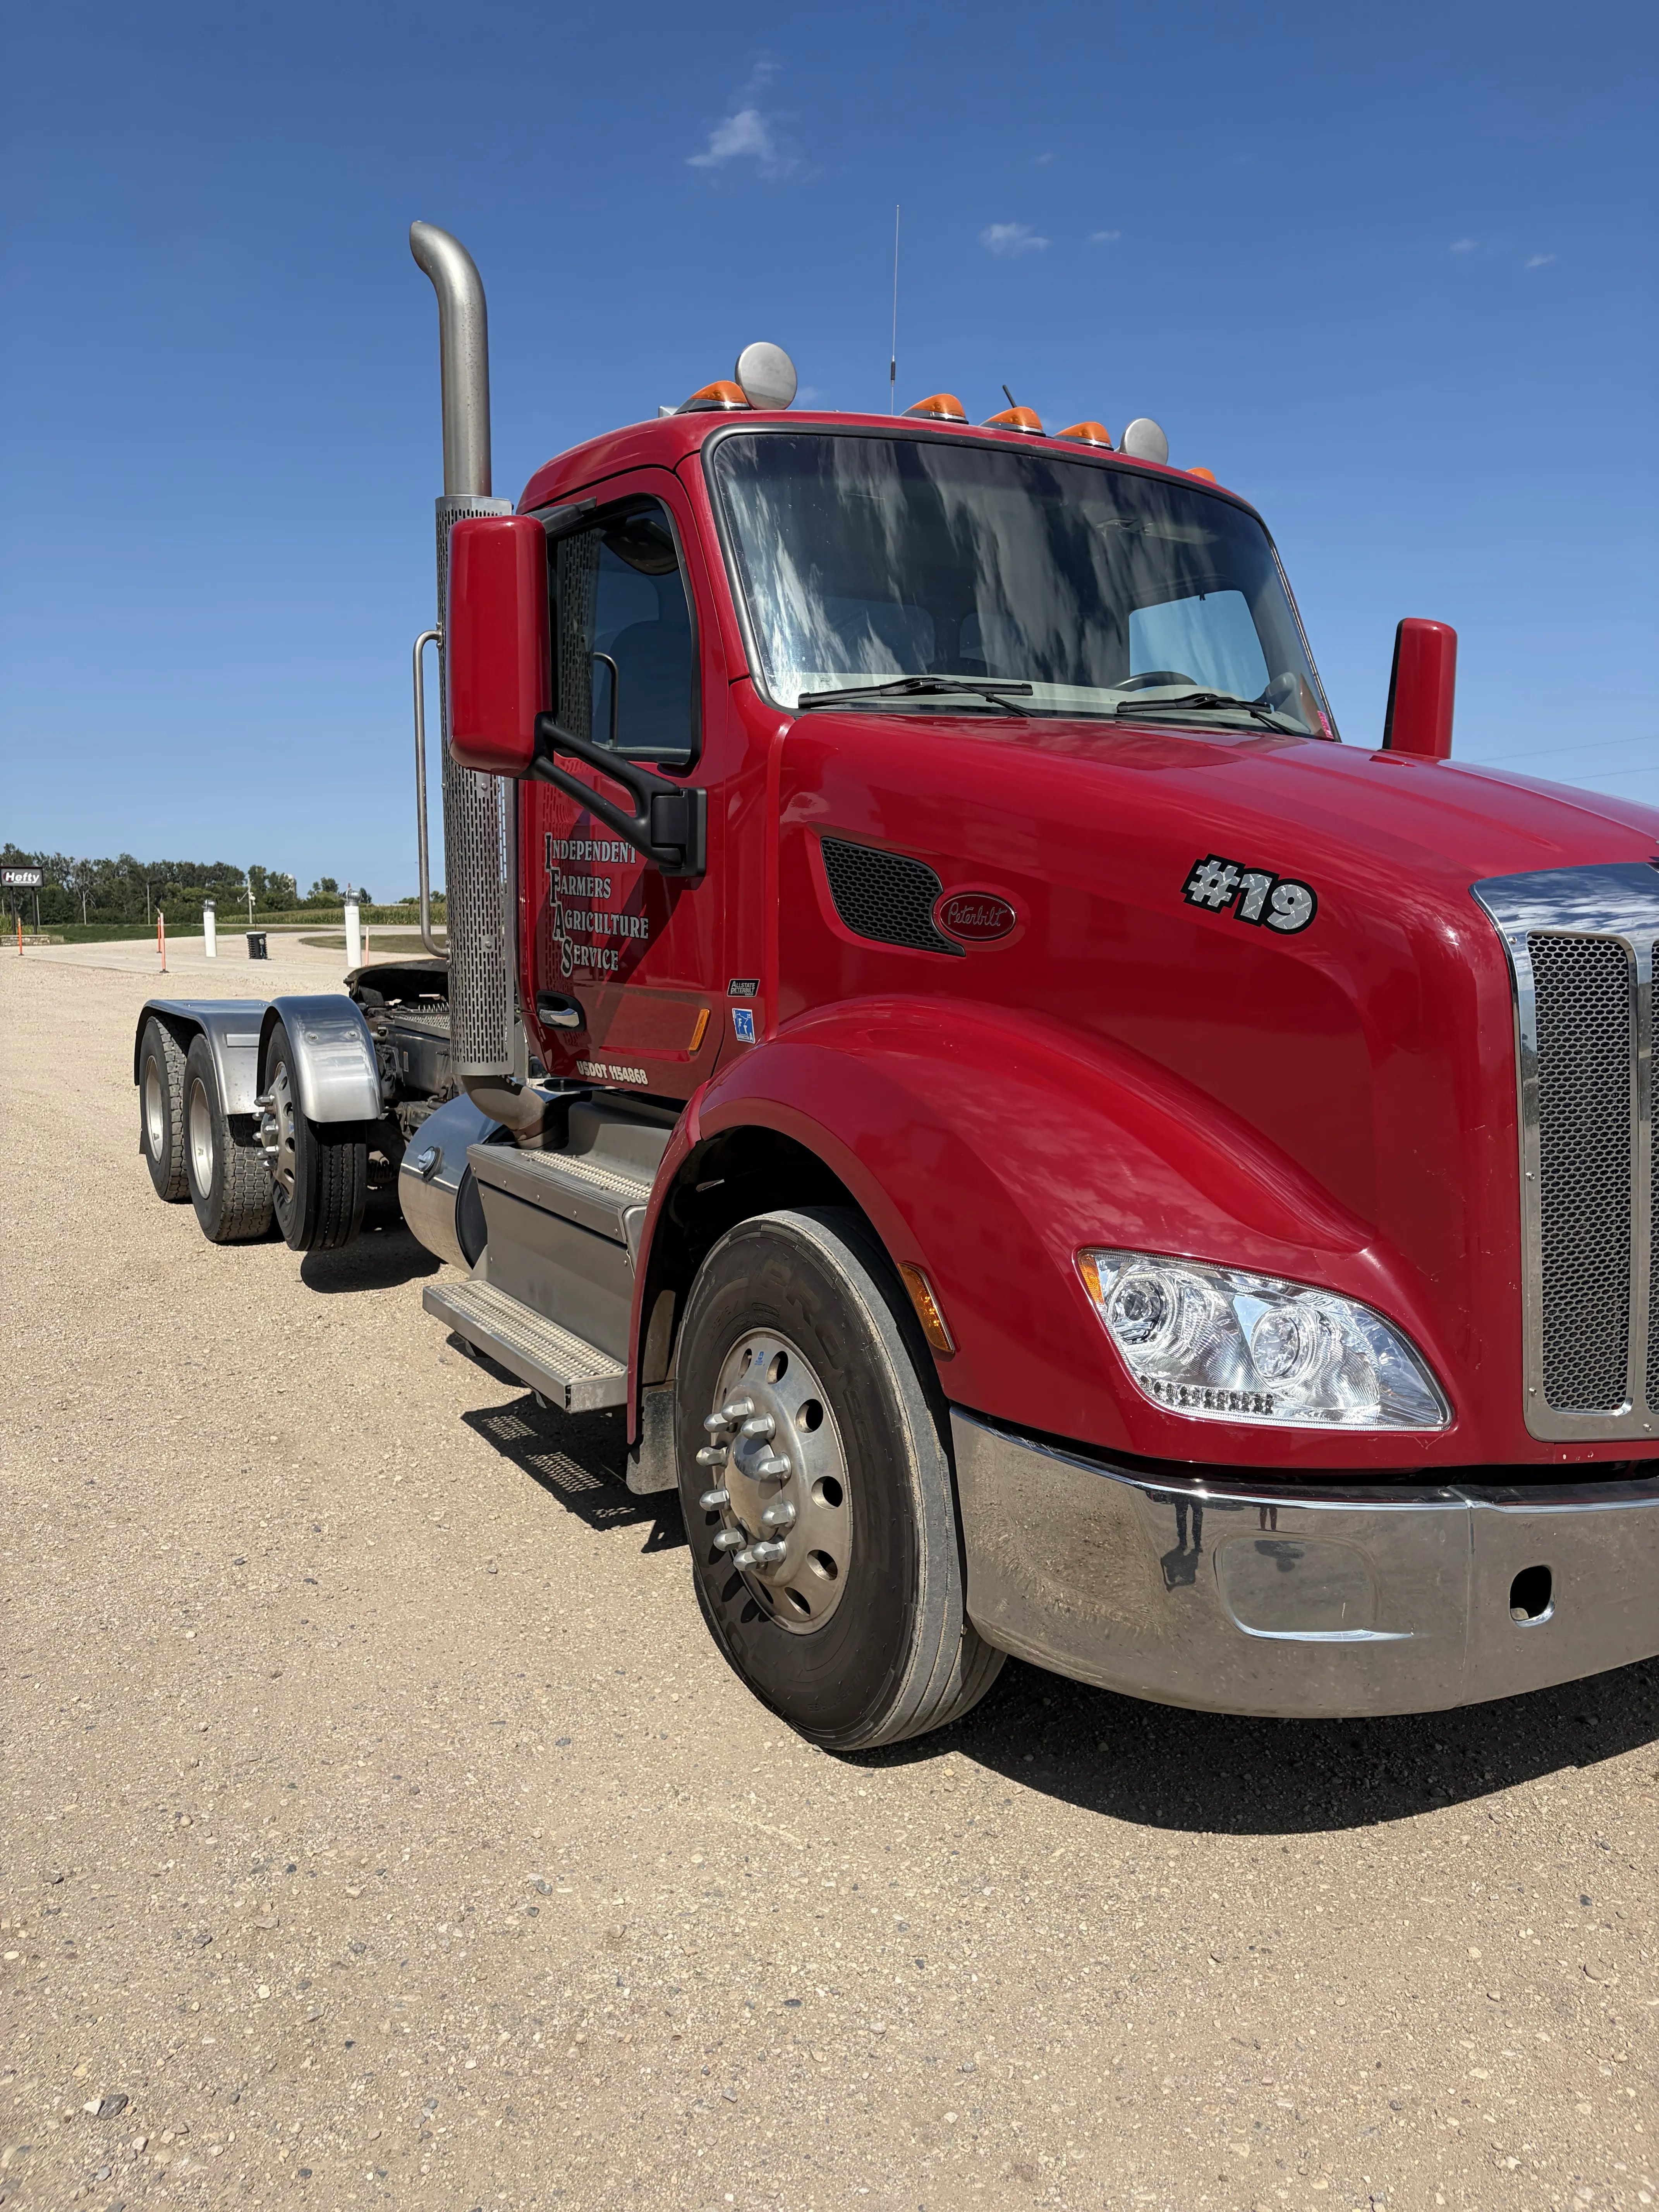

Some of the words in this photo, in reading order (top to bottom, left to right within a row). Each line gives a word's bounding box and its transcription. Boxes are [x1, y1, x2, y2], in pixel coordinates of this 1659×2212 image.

[545, 832, 636, 872] INDEPENDENT
[5, 872, 40, 884] Hefty
[550, 867, 611, 907] FARMERS
[1181, 854, 1317, 934] #19
[552, 902, 649, 941] AGRICULTURE
[948, 902, 1007, 926] Peterbilt
[561, 936, 618, 977] SERVICE
[576, 1060, 608, 1079] USDOT
[608, 1065, 648, 1085] 1154868
